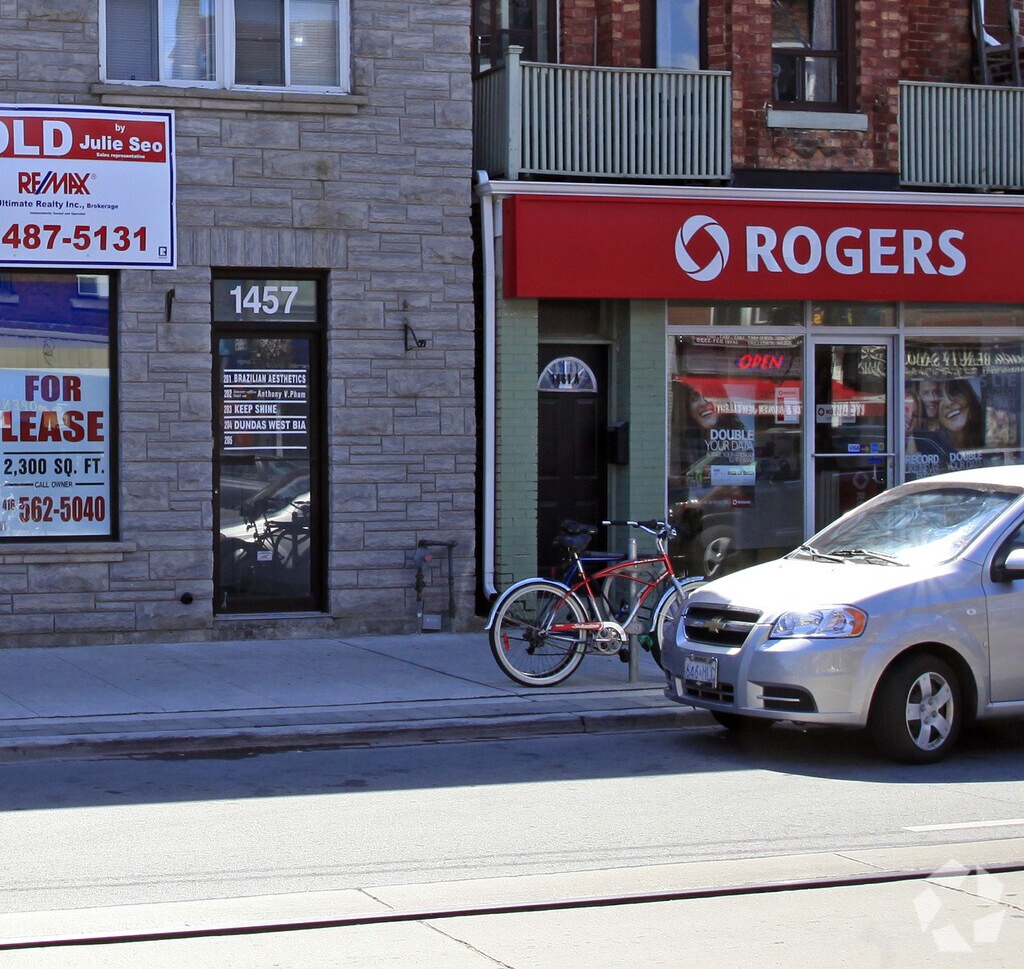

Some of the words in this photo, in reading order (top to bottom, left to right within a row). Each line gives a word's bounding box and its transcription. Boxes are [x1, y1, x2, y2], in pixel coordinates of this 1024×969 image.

[114, 123, 126, 134] by
[79, 133, 123, 151] Julie
[129, 136, 163, 154] Seo
[36, 200, 64, 210] Realty
[66, 200, 85, 210] Inc.,
[2, 224, 146, 252] 487-5131
[745, 225, 966, 277] ROGERS
[230, 285, 298, 314] 1457
[738, 354, 784, 370] OPEN
[234, 374, 266, 383] BRAZILIAN
[268, 374, 306, 384] AESTHETICS
[25, 375, 81, 402] FOR
[257, 389, 282, 400] Anthony
[234, 404, 253, 414] KEEP
[255, 404, 277, 414] SHINE
[2, 410, 104, 442] LEASE
[234, 420, 266, 430] DUNDAS
[268, 420, 290, 430] WEST
[293, 420, 306, 430] BIA
[710, 430, 754, 440] DOUBLE
[704, 440, 729, 451] YOUR
[730, 440, 754, 451] DATA
[906, 454, 940, 464] RECORD
[950, 452, 982, 462] DOUBLE
[4, 458, 46, 477] 2,300
[54, 458, 77, 477] SQ.
[84, 458, 105, 474] FT.
[19, 496, 105, 522] 562-5040
